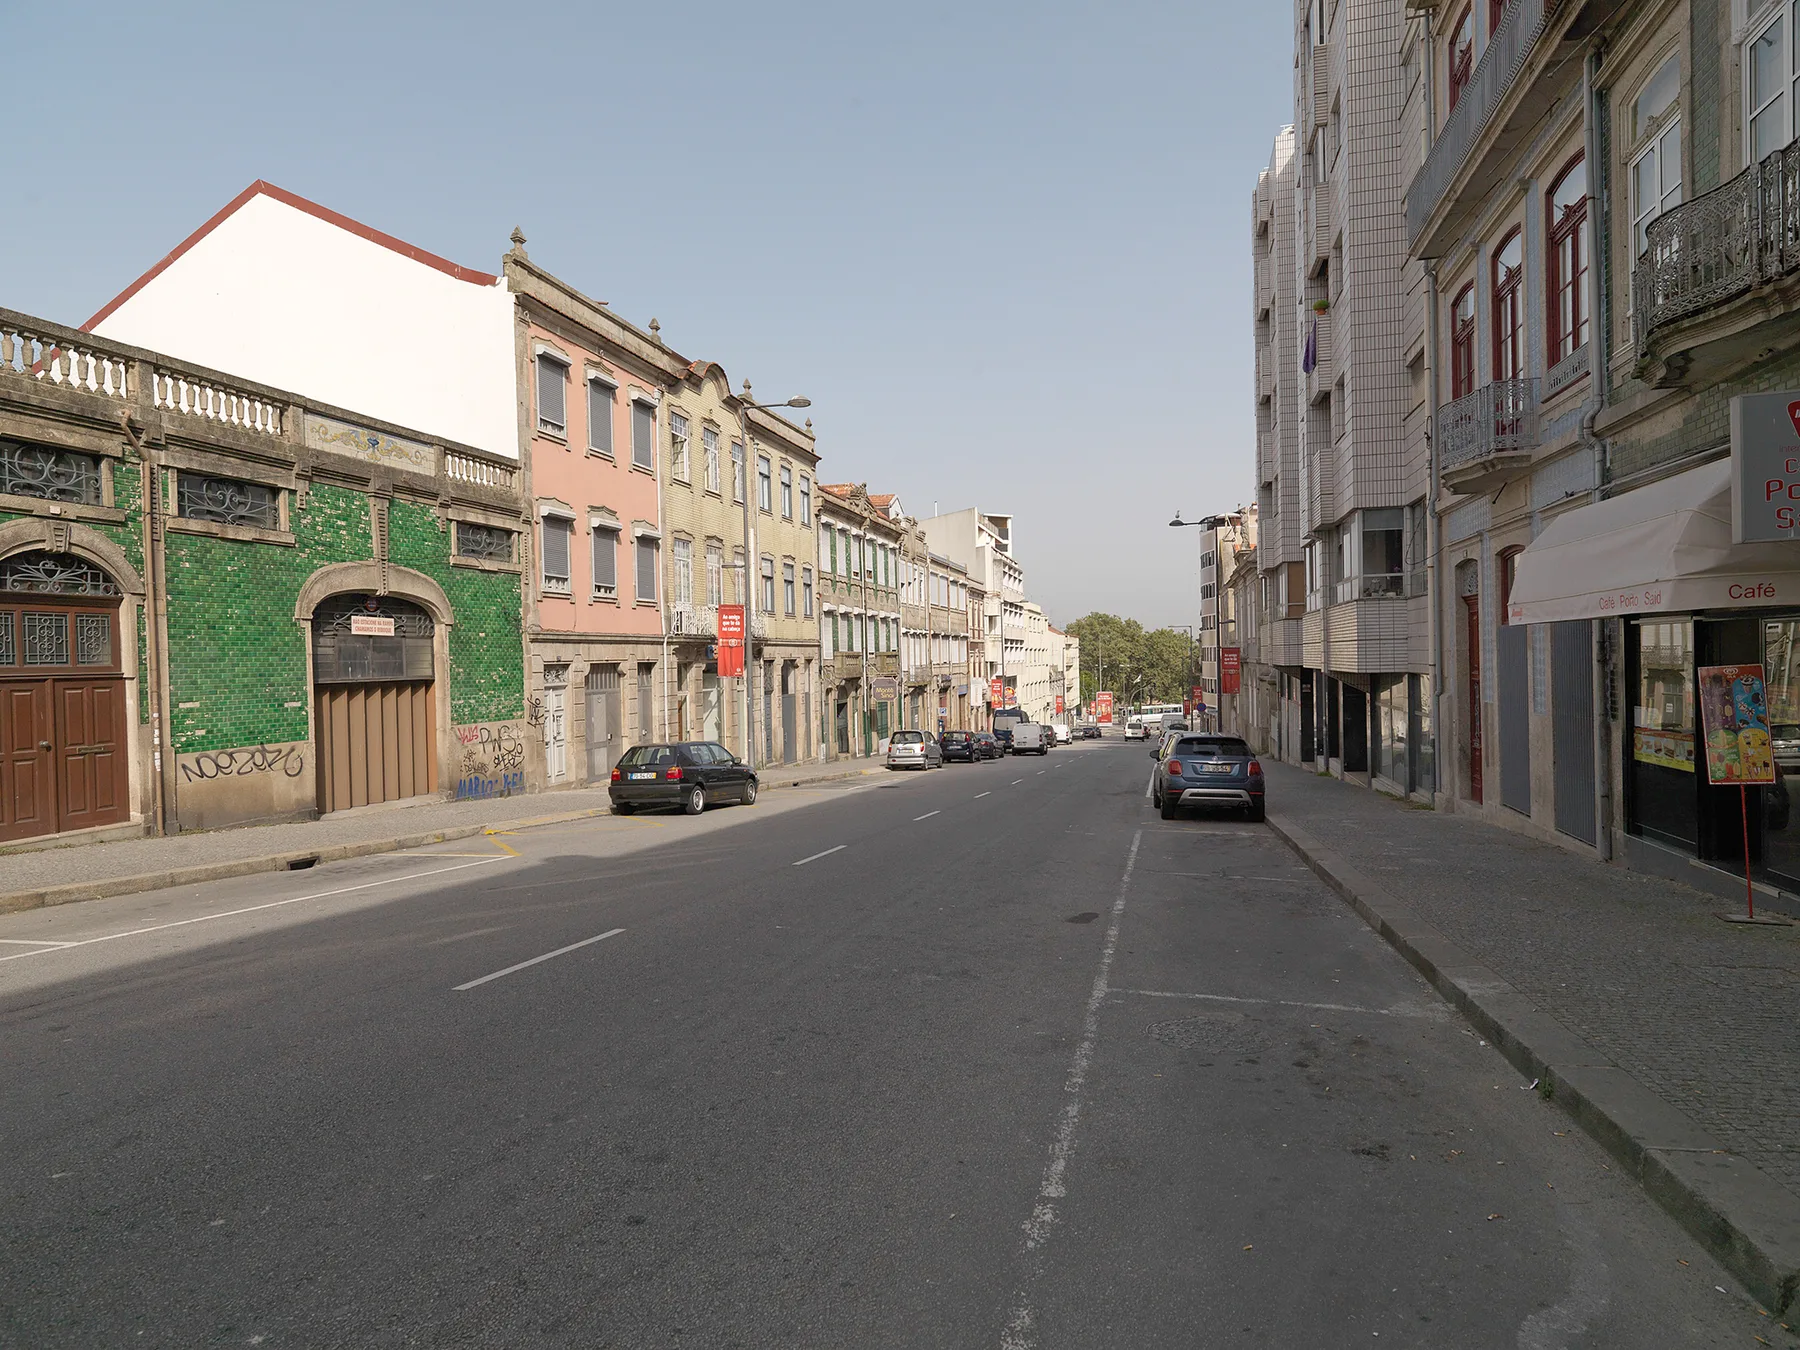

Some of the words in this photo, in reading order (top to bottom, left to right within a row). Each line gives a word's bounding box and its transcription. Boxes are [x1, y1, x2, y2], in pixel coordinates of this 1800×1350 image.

[1785, 457, 1800, 474] C
[1775, 506, 1800, 529] S
[1599, 596, 1616, 610] Café
[1619, 593, 1639, 608] Porto
[1644, 590, 1662, 606] Said
[1728, 582, 1775, 600] Café
